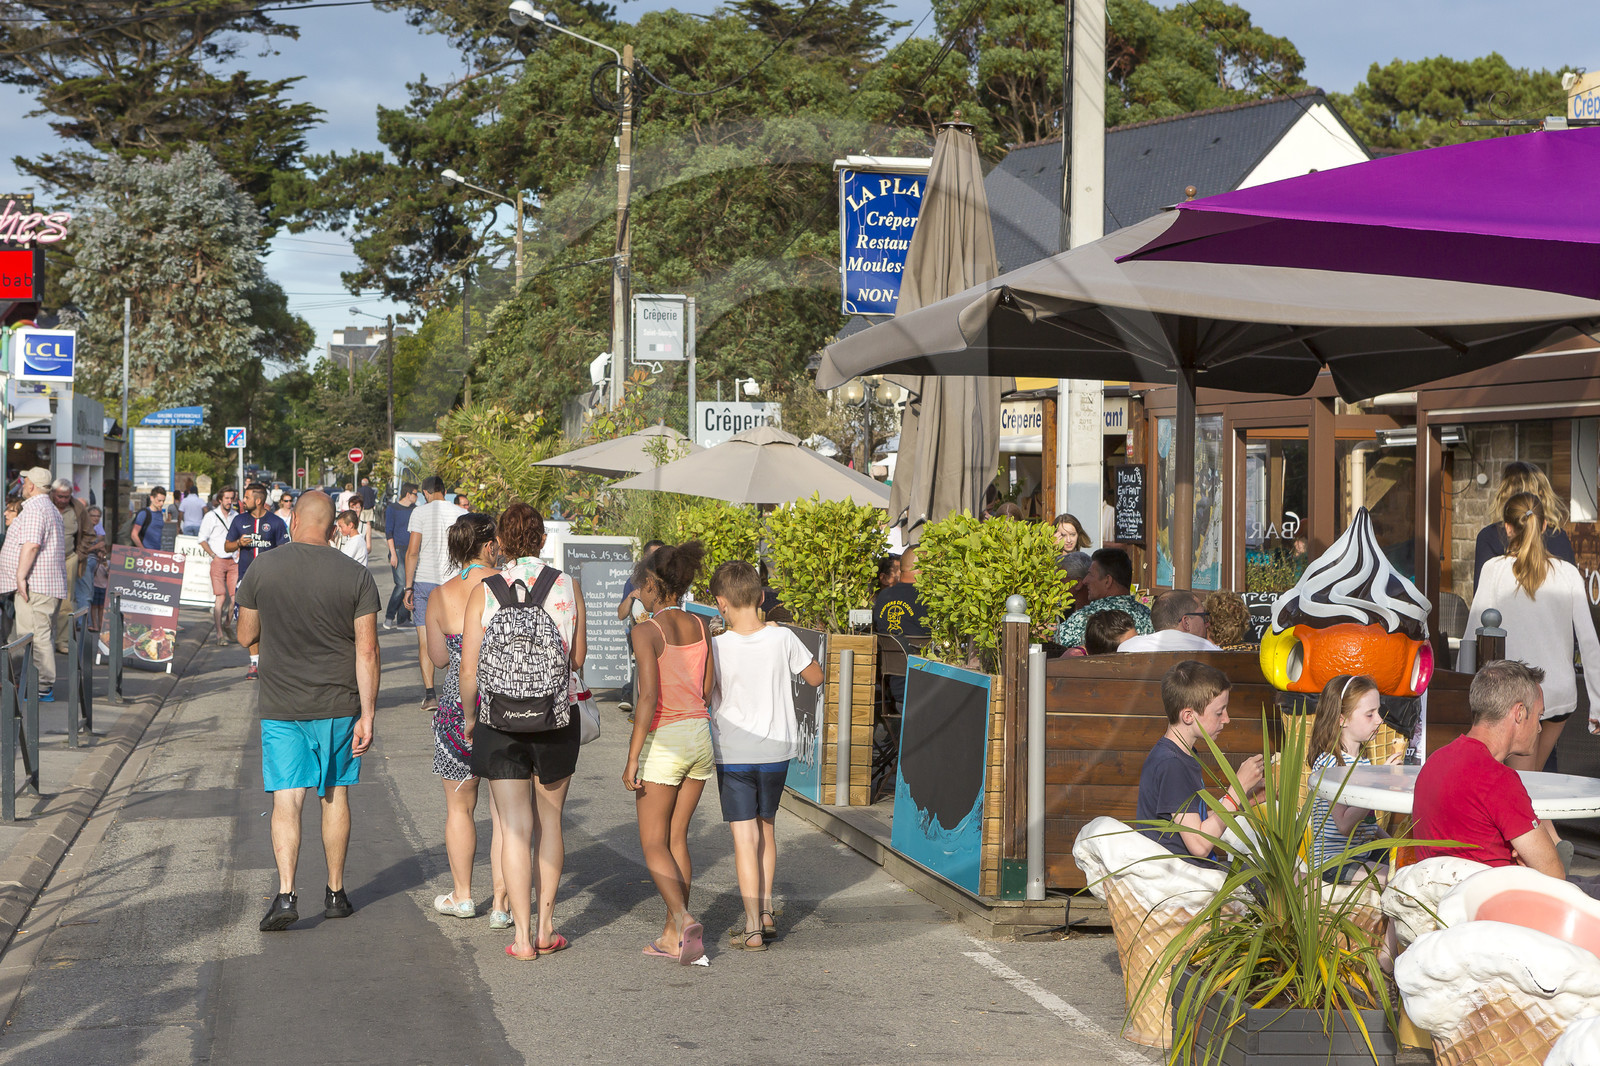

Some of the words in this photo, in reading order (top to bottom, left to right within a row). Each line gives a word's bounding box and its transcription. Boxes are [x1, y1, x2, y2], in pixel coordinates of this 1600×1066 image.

[1574, 91, 1600, 119] Crêp
[846, 186, 876, 212] LA
[879, 178, 924, 198] PLA
[855, 234, 911, 250] Restau
[857, 288, 898, 302] NON-
[643, 308, 678, 323] Crêperie
[25, 342, 68, 358] LCL
[705, 407, 768, 435] Crêperi
[1001, 407, 1042, 434] Crêperie
[567, 548, 590, 559] Menu
[591, 550, 597, 559] à
[124, 557, 180, 573] Baobab
[132, 580, 157, 591] BAR
